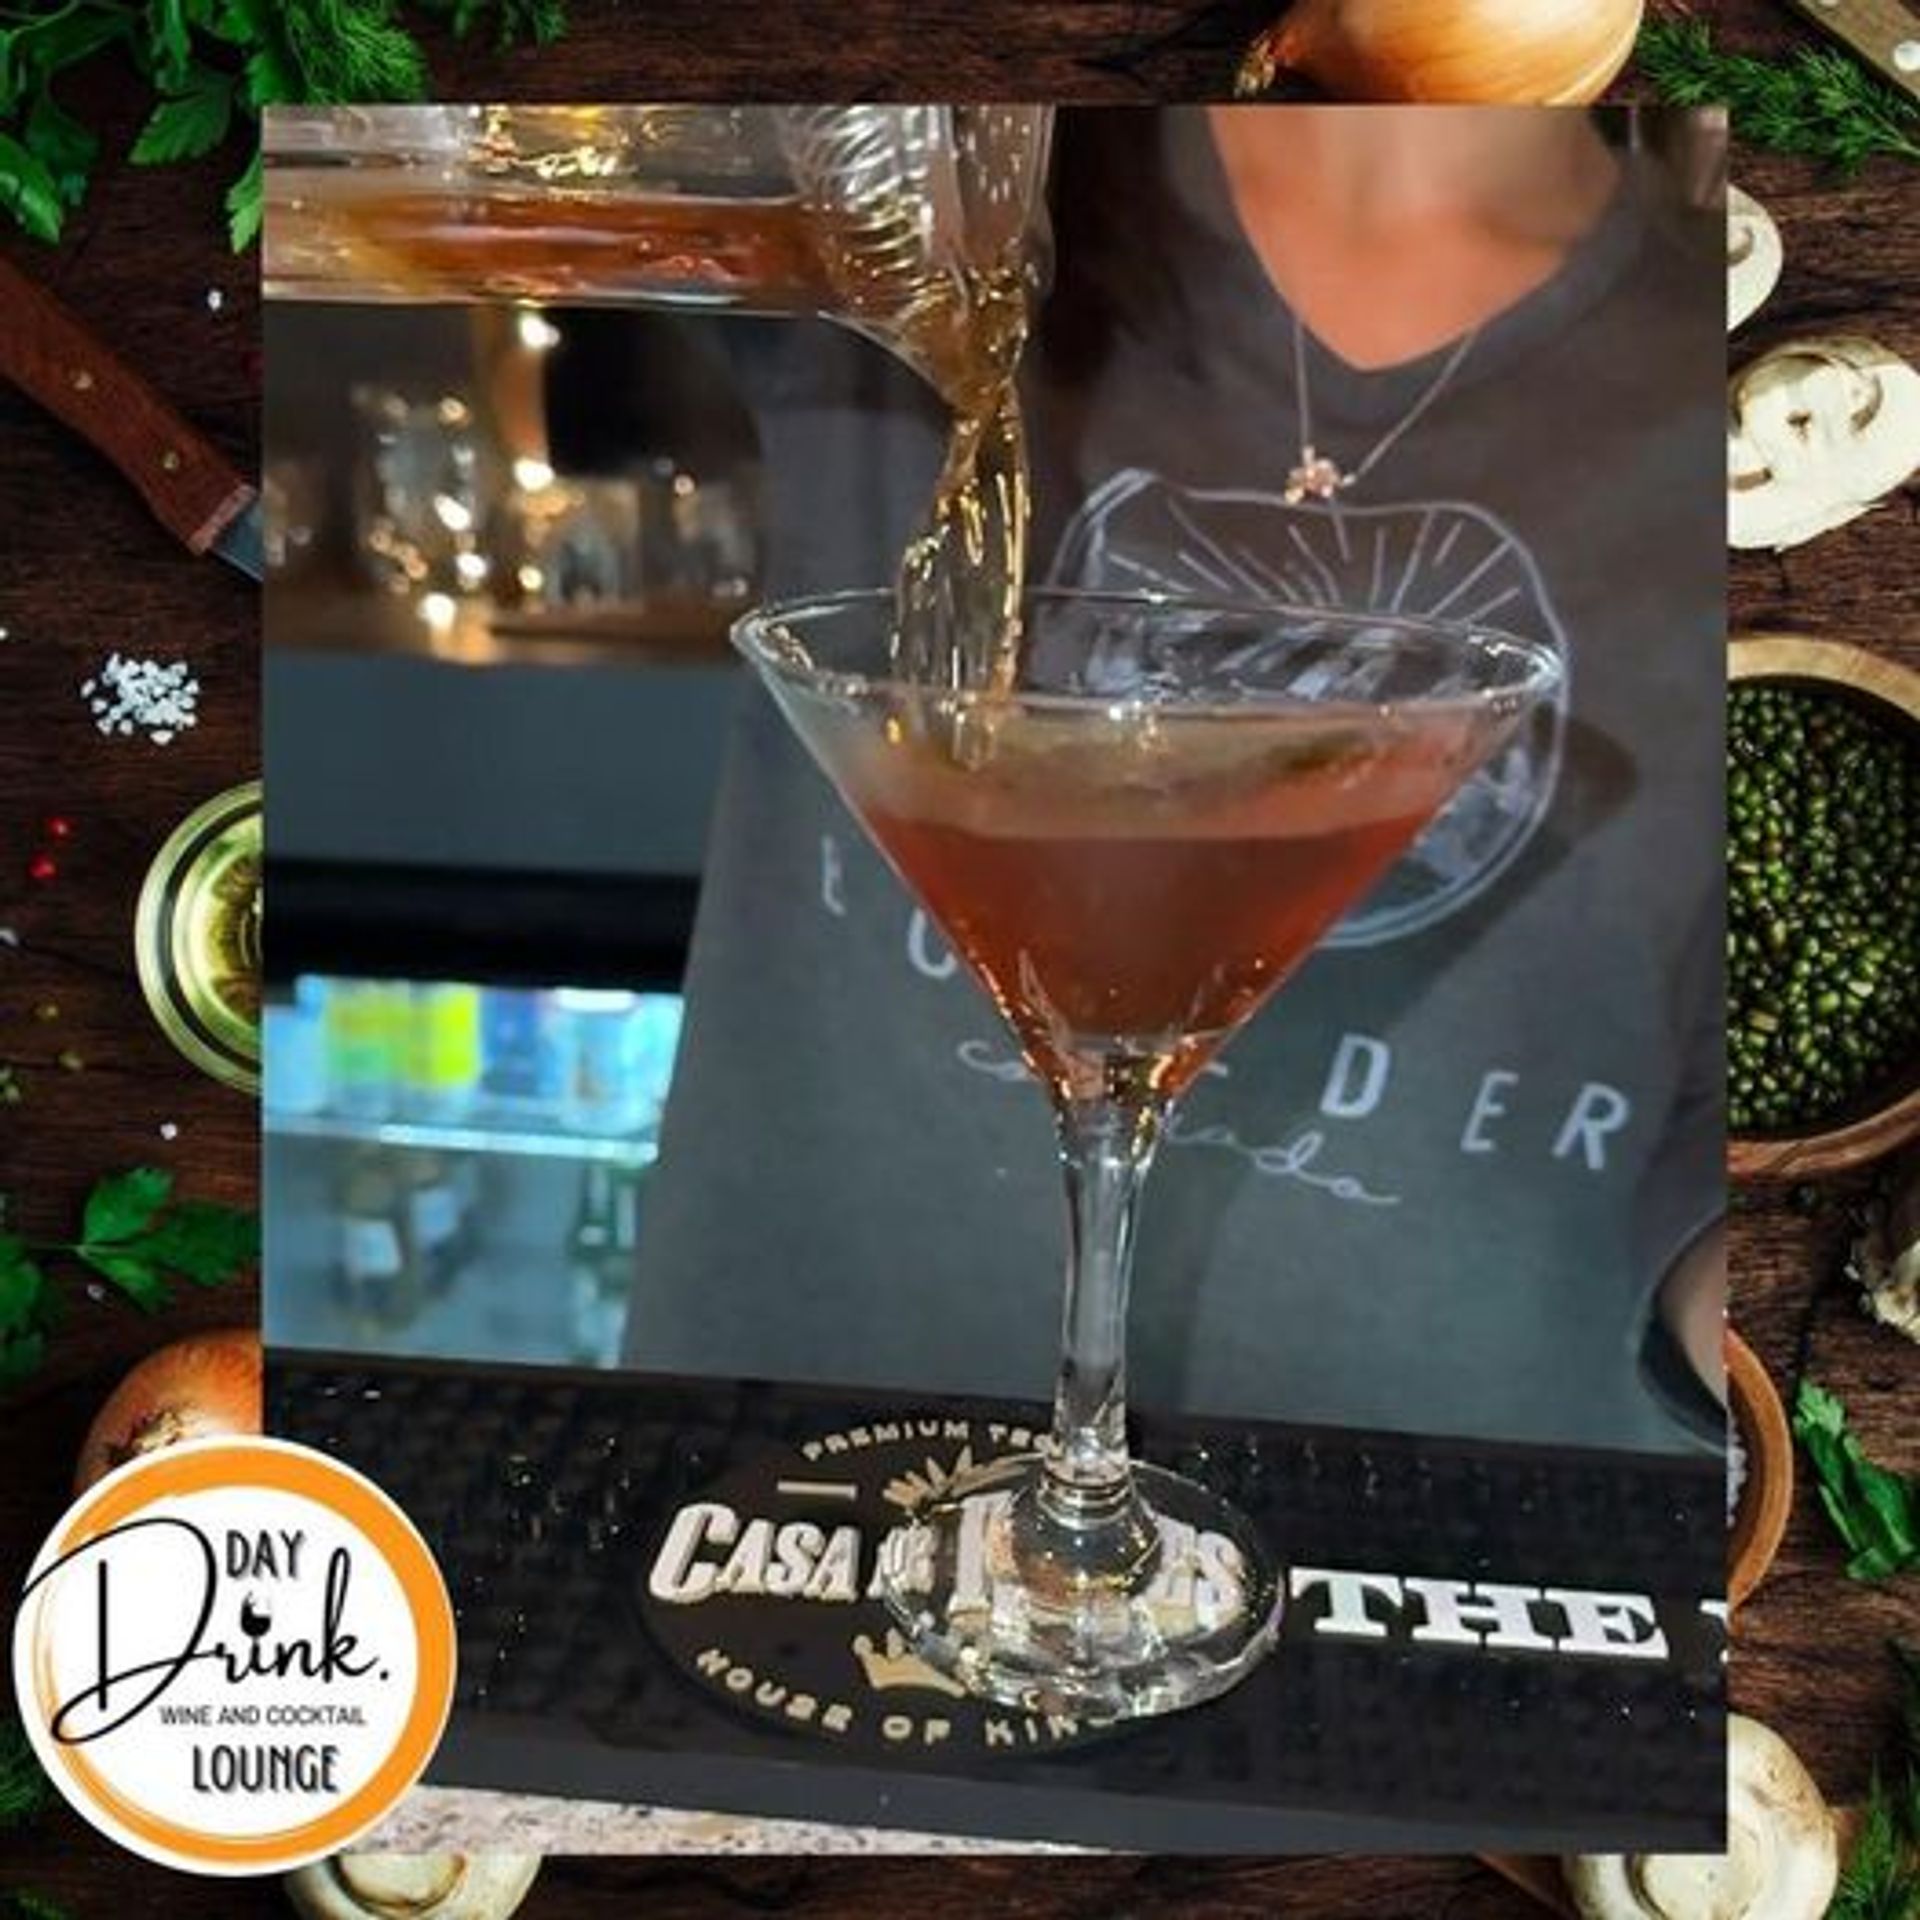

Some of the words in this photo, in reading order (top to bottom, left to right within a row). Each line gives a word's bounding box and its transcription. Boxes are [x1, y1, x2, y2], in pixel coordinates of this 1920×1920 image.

[802, 1419, 970, 1461] PREMIUM
[649, 1502, 861, 1604] CASA
[1290, 1566, 1670, 1660] THE
[882, 1714, 951, 1746] OF
